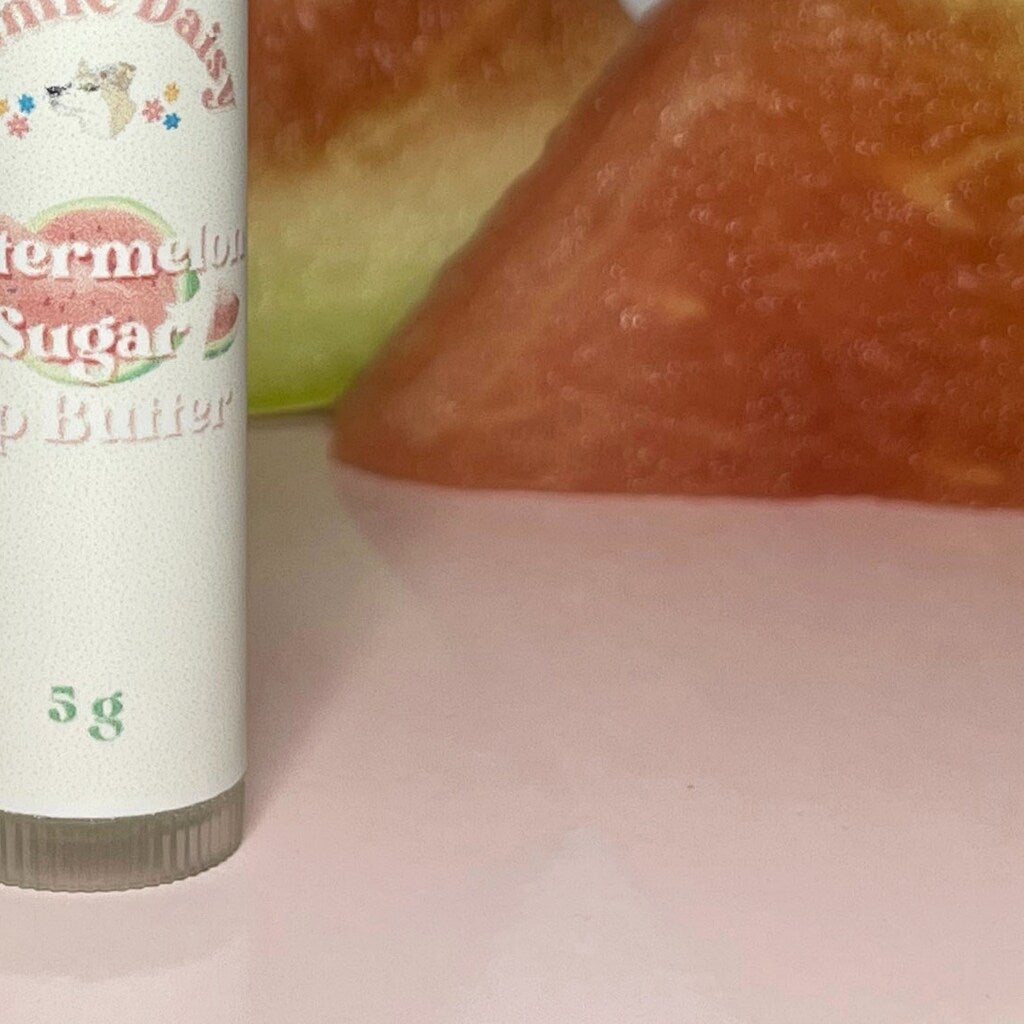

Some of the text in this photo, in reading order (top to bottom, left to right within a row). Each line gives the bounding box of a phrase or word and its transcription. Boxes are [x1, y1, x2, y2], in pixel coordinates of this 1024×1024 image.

[43, 388, 235, 445] Butter
[48, 685, 124, 741] 5 g
